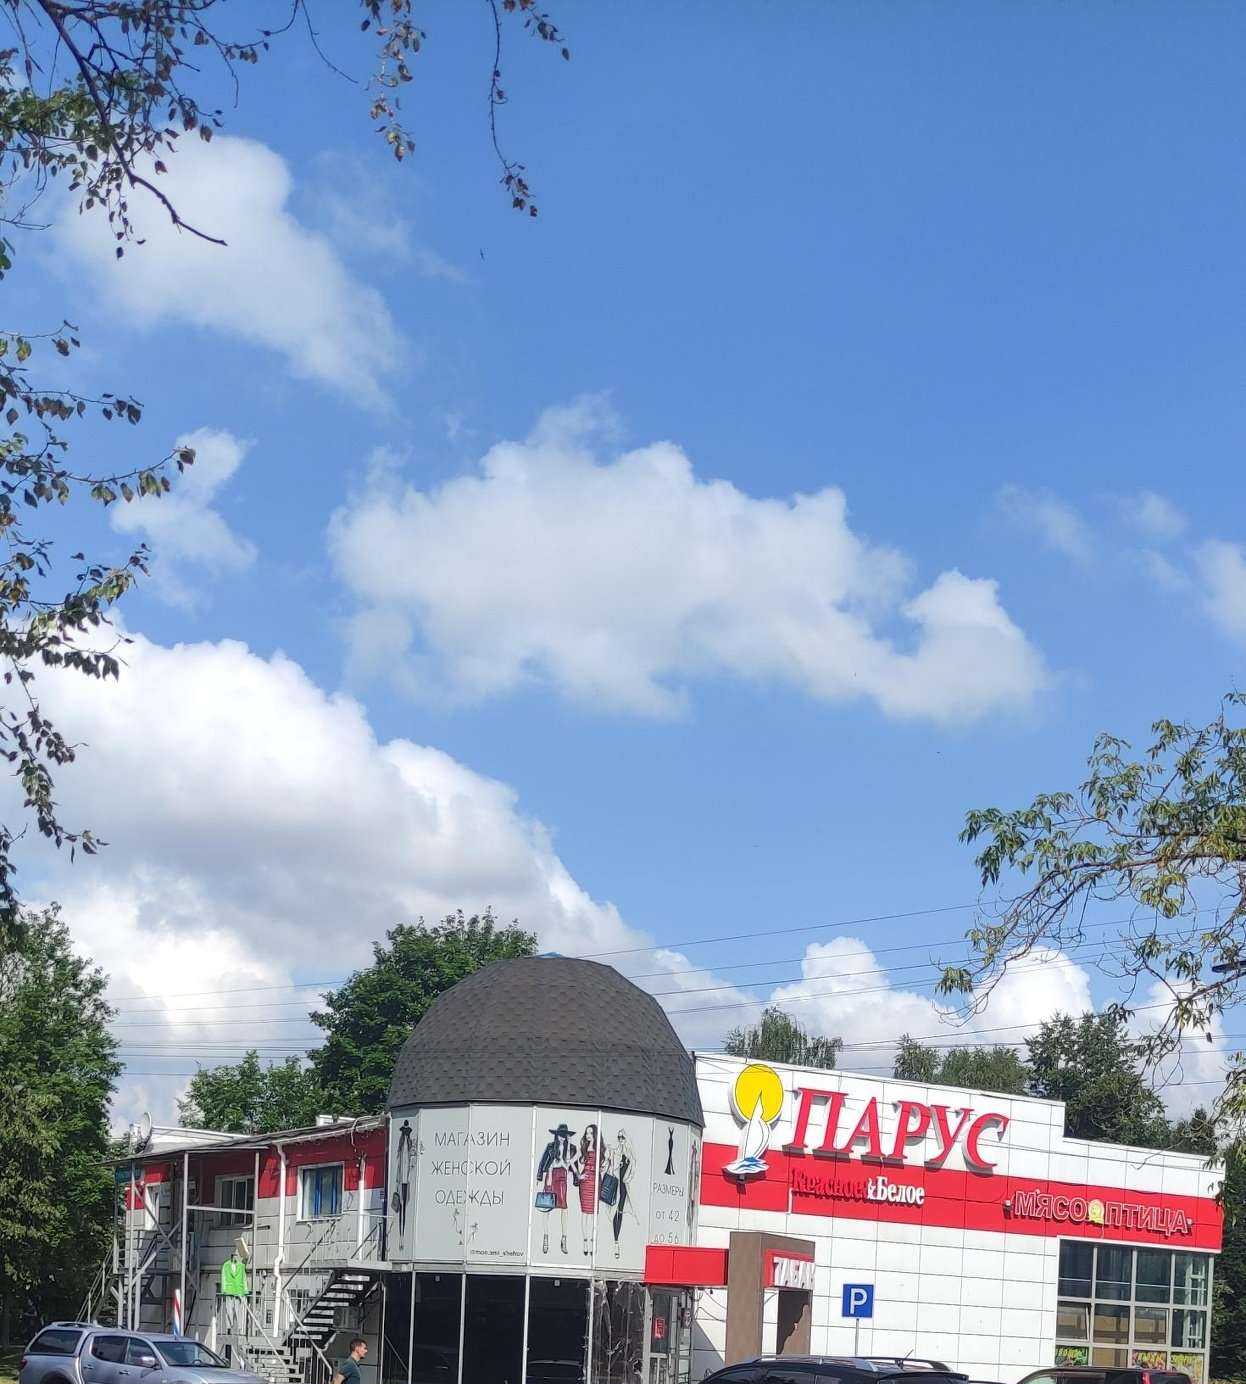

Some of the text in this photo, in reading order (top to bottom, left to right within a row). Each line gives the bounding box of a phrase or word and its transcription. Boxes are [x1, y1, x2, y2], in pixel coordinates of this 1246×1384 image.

[785, 1087, 1010, 1170] ПАРУС
[434, 1131, 510, 1147] МАГАЗИН
[431, 1159, 511, 1176] ЖЕНСКОЙ
[435, 1189, 505, 1207] ОДЕЖДЫ
[652, 1182, 685, 1198] РАЗМЕРЫ
[668, 1209, 681, 1222] 42
[1014, 1190, 1189, 1237] МЯСО ПТИЦА
[850, 1288, 868, 1315] P
